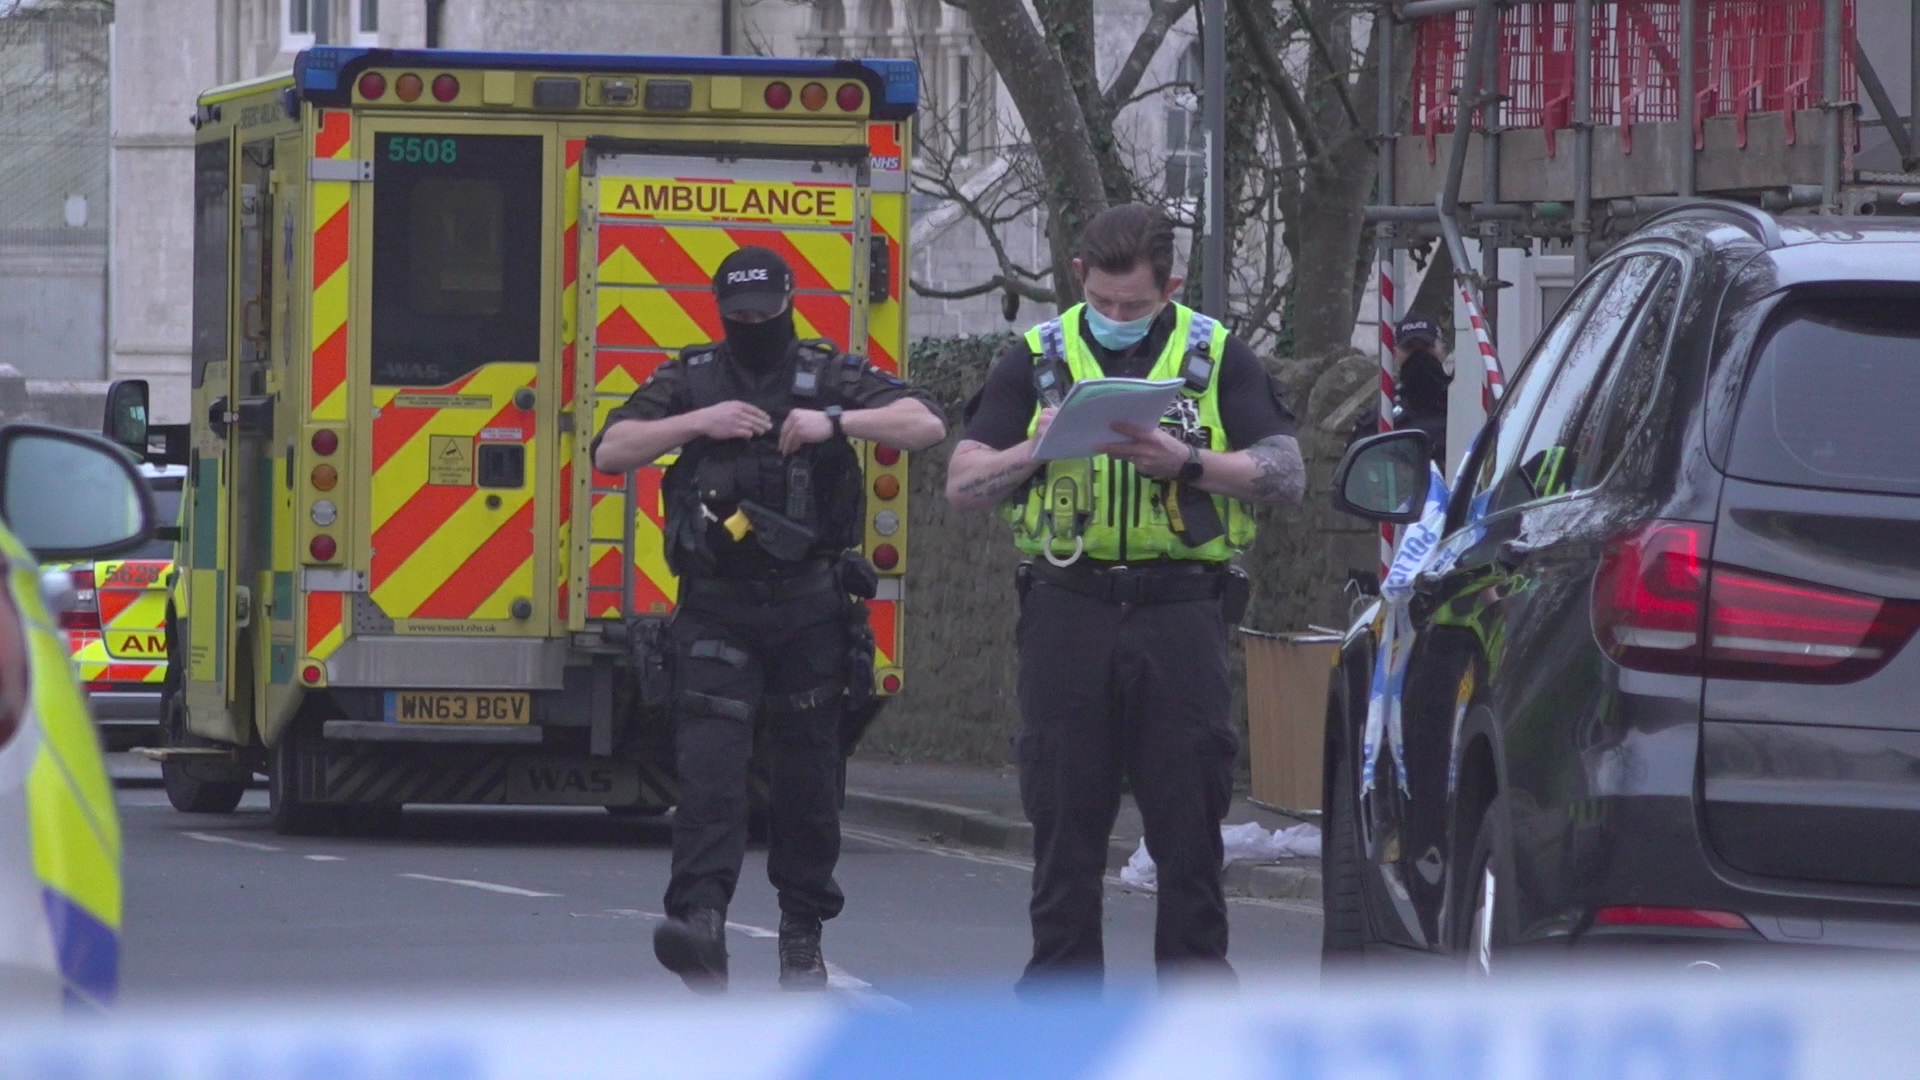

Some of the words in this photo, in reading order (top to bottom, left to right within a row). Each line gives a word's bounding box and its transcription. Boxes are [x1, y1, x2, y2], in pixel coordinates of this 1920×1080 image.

[388, 138, 457, 163] 5508
[871, 157, 899, 169] NHS
[617, 184, 836, 217] AMBULANCE
[727, 269, 768, 284] POLICE
[1401, 321, 1428, 332] POLICE
[386, 362, 440, 379] WAS
[105, 564, 159, 584] 5628
[408, 623, 497, 633] www.swast.nhs.uk
[401, 695, 468, 720] WN63
[476, 695, 525, 720] BGV
[528, 767, 613, 793] WAS
